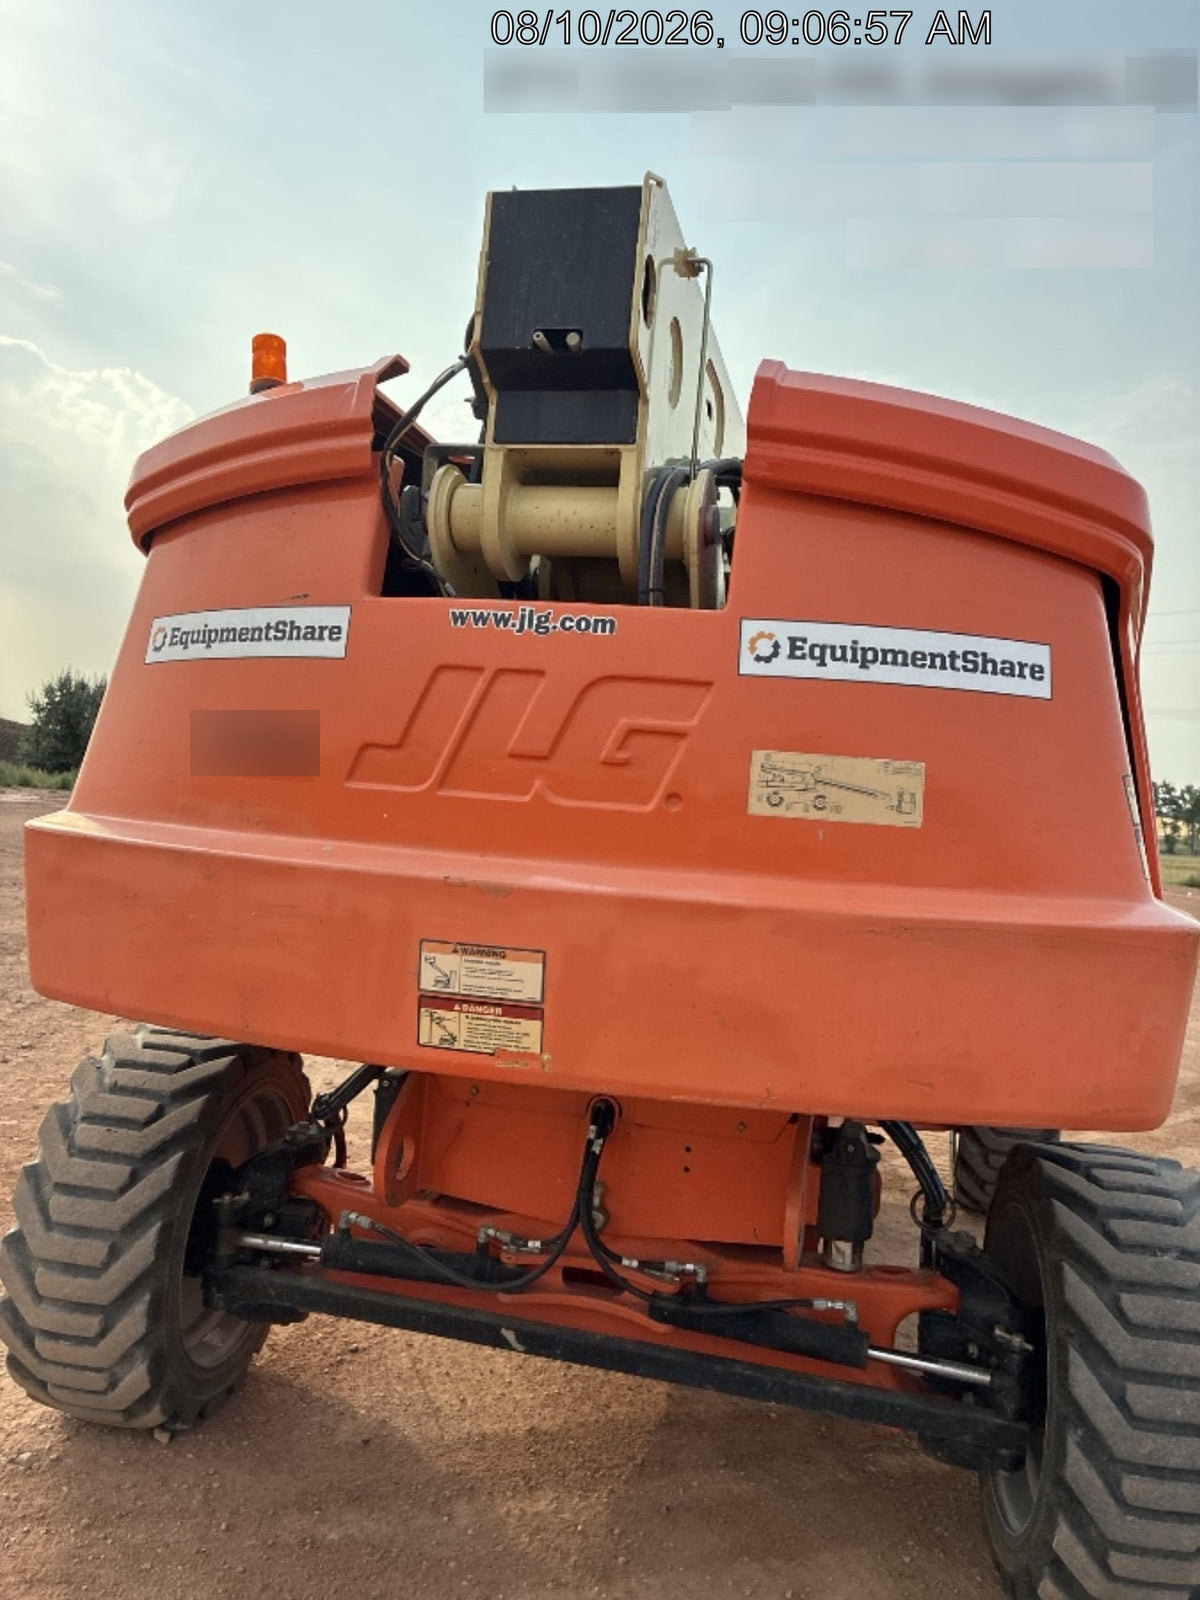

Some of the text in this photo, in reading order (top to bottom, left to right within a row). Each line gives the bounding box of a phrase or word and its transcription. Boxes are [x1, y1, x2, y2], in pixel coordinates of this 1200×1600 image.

[168, 620, 343, 649] EquipmentShare
[449, 607, 617, 636] www.jlg.com
[787, 636, 1045, 682] EquipmentShare
[345, 664, 714, 812] JLG
[460, 947, 506, 959] WARNING
[461, 1004, 503, 1016] DANGER
